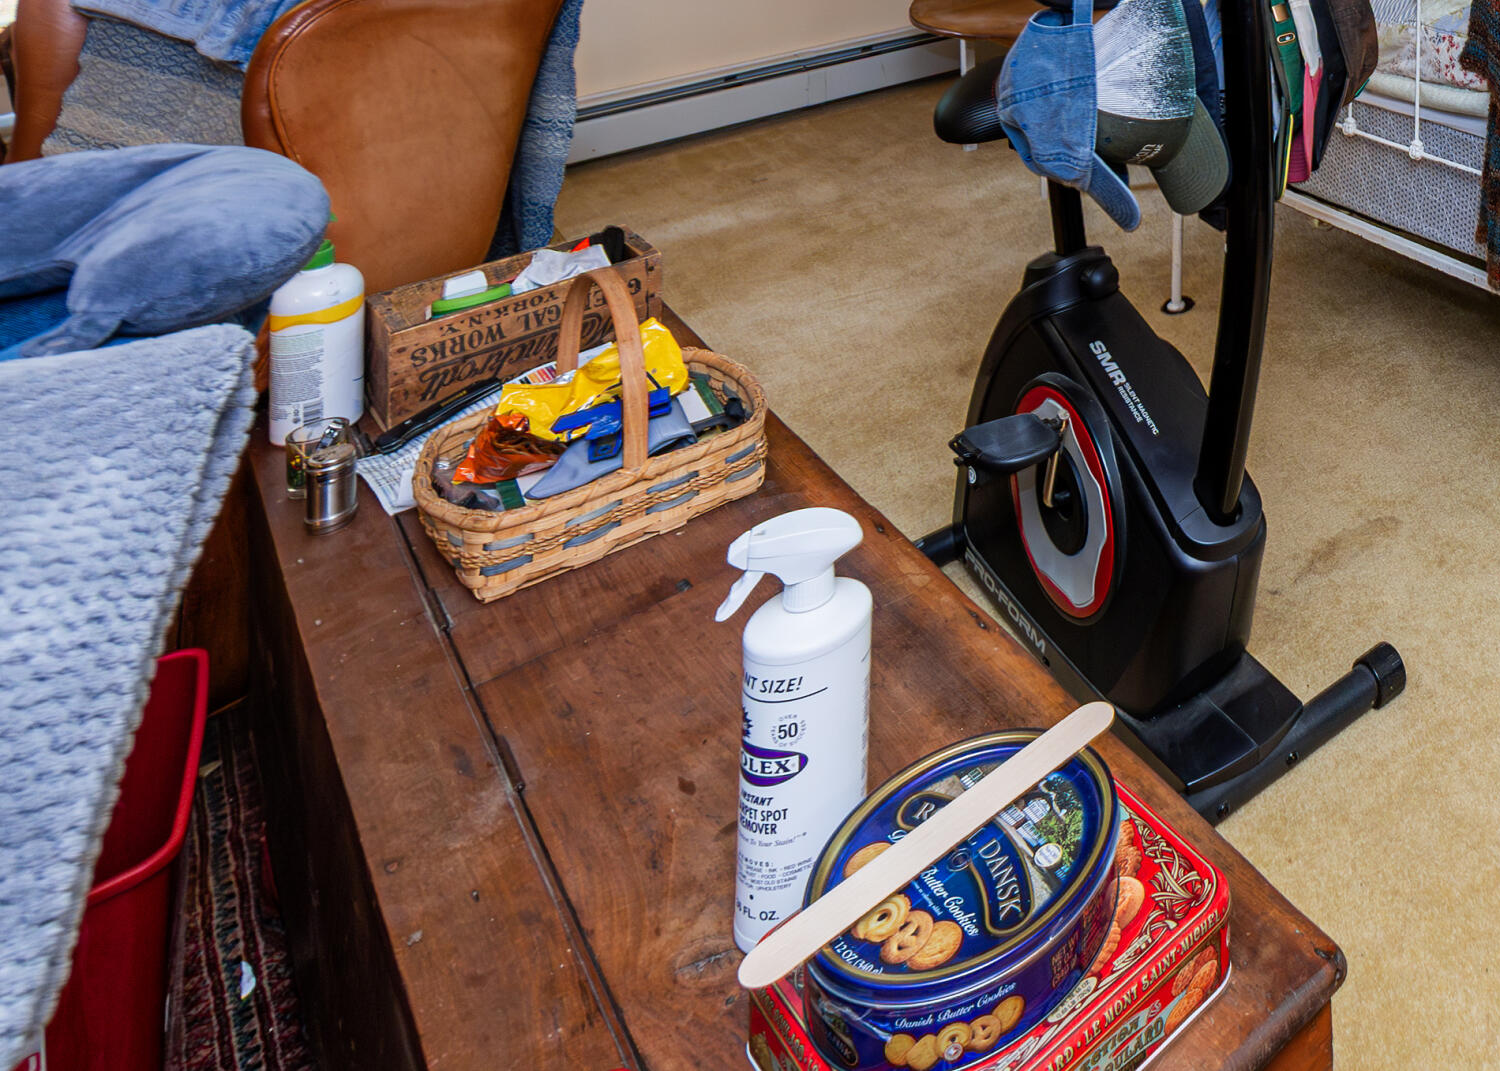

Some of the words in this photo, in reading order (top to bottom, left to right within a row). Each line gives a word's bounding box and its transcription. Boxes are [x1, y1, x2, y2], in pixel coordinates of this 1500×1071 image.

[409, 322, 507, 368] WORKS
[1089, 340, 1127, 386] SMR
[1117, 385, 1144, 423] RESISTANCE
[1124, 382, 1140, 403] SILENT
[1136, 402, 1160, 436] MAGNETIC
[964, 550, 1047, 653] PRO-FORM
[759, 676, 804, 694] SIZE!
[777, 722, 799, 740] 50
[760, 808, 788, 822] SPOT
[920, 866, 950, 899] Butter
[943, 896, 980, 937] Cookies
[979, 839, 1022, 921] DANSK
[759, 910, 780, 921] OZ.
[895, 1013, 934, 1029] Danish
[937, 1004, 975, 1022] Butter
[976, 982, 1017, 1008] Cookies
[1083, 1018, 1102, 1046] LE
[1103, 985, 1139, 1028] MONT
